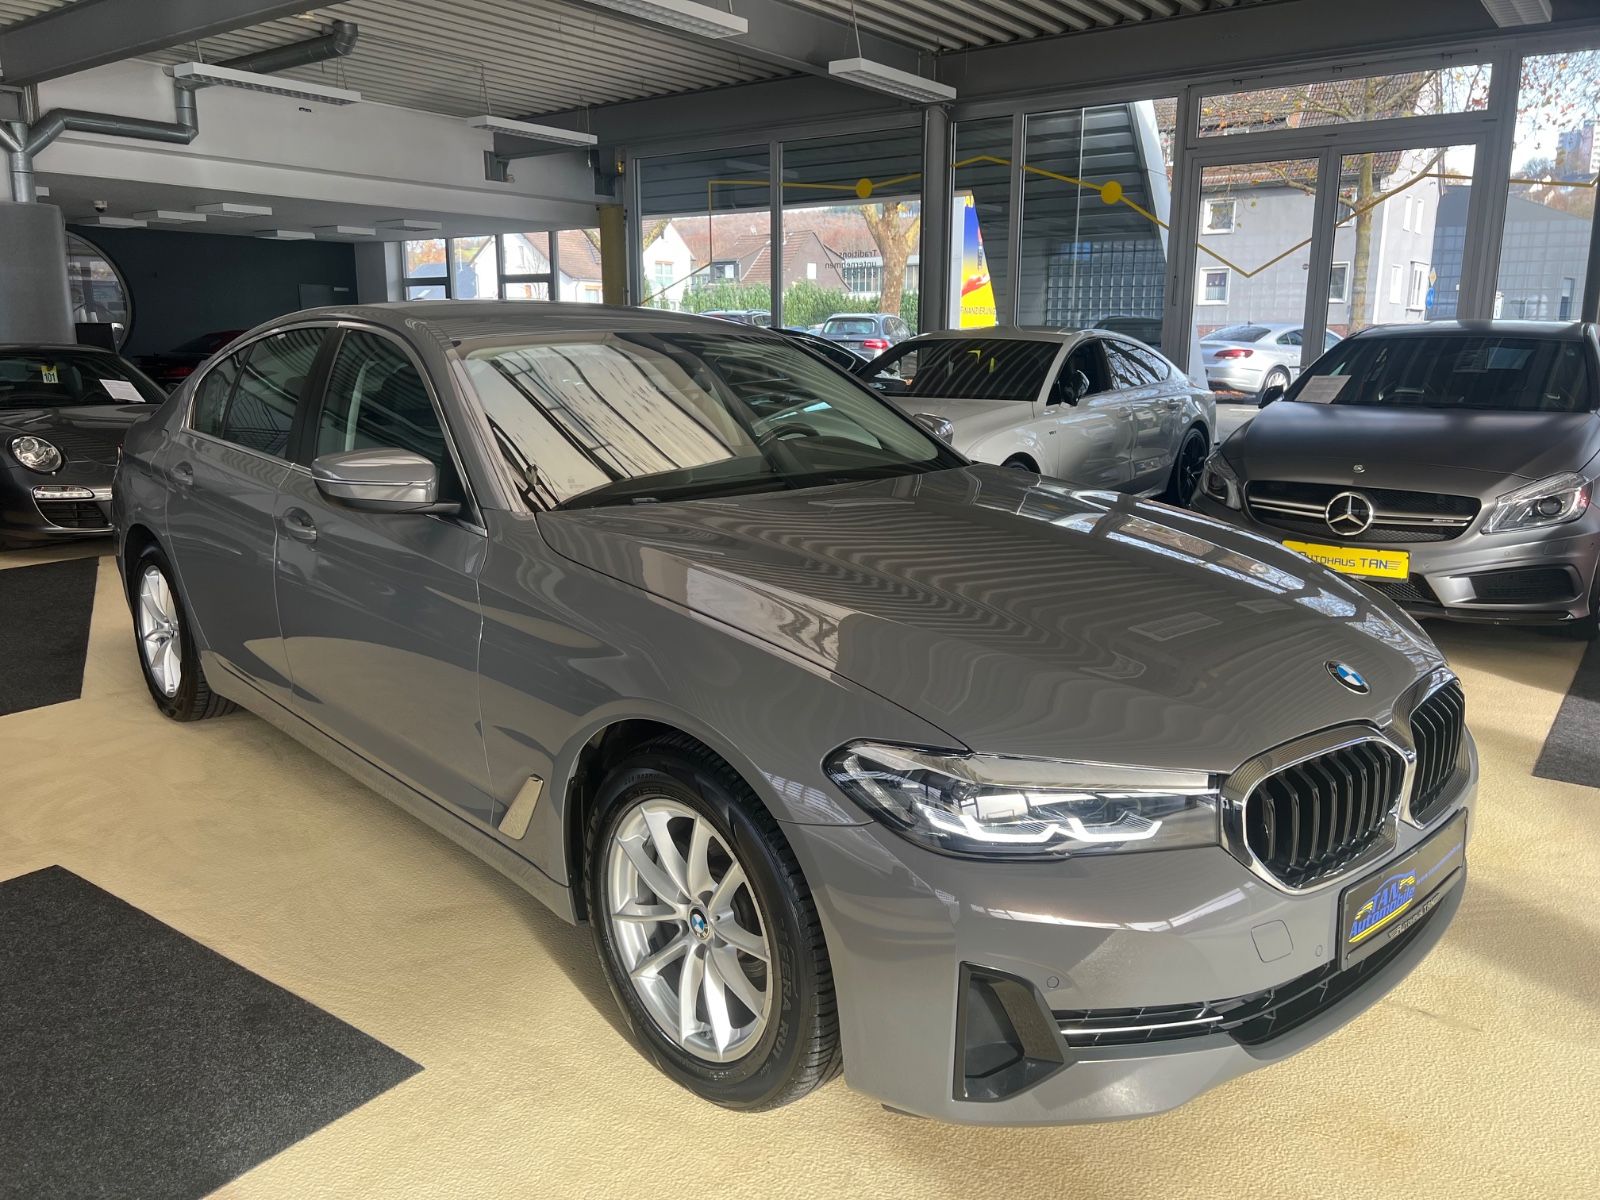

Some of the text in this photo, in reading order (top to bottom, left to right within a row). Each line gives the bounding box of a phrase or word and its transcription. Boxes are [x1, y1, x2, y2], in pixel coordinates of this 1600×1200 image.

[44, 372, 56, 383] 101
[1360, 557, 1388, 570] TAN
[1371, 882, 1401, 914] TAN
